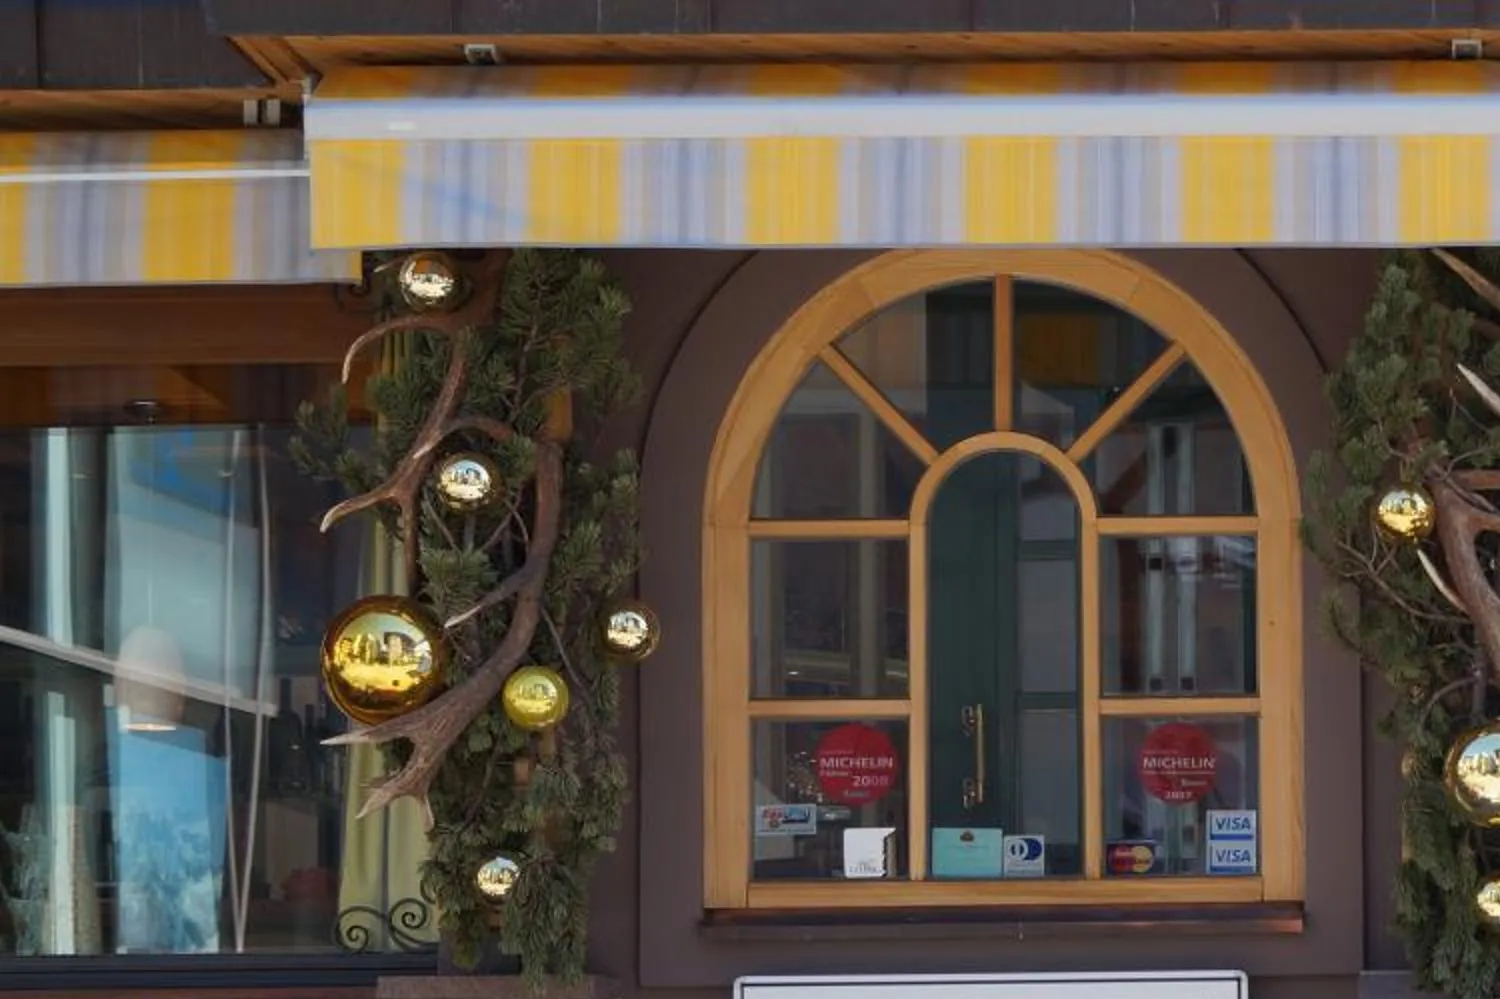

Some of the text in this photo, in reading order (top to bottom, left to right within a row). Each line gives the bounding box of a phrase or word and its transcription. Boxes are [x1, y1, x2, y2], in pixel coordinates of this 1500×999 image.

[819, 757, 893, 769] MICHELIN
[1142, 757, 1215, 769] MICHELIN
[1215, 818, 1251, 830] VISA
[1215, 850, 1251, 862] VISA
